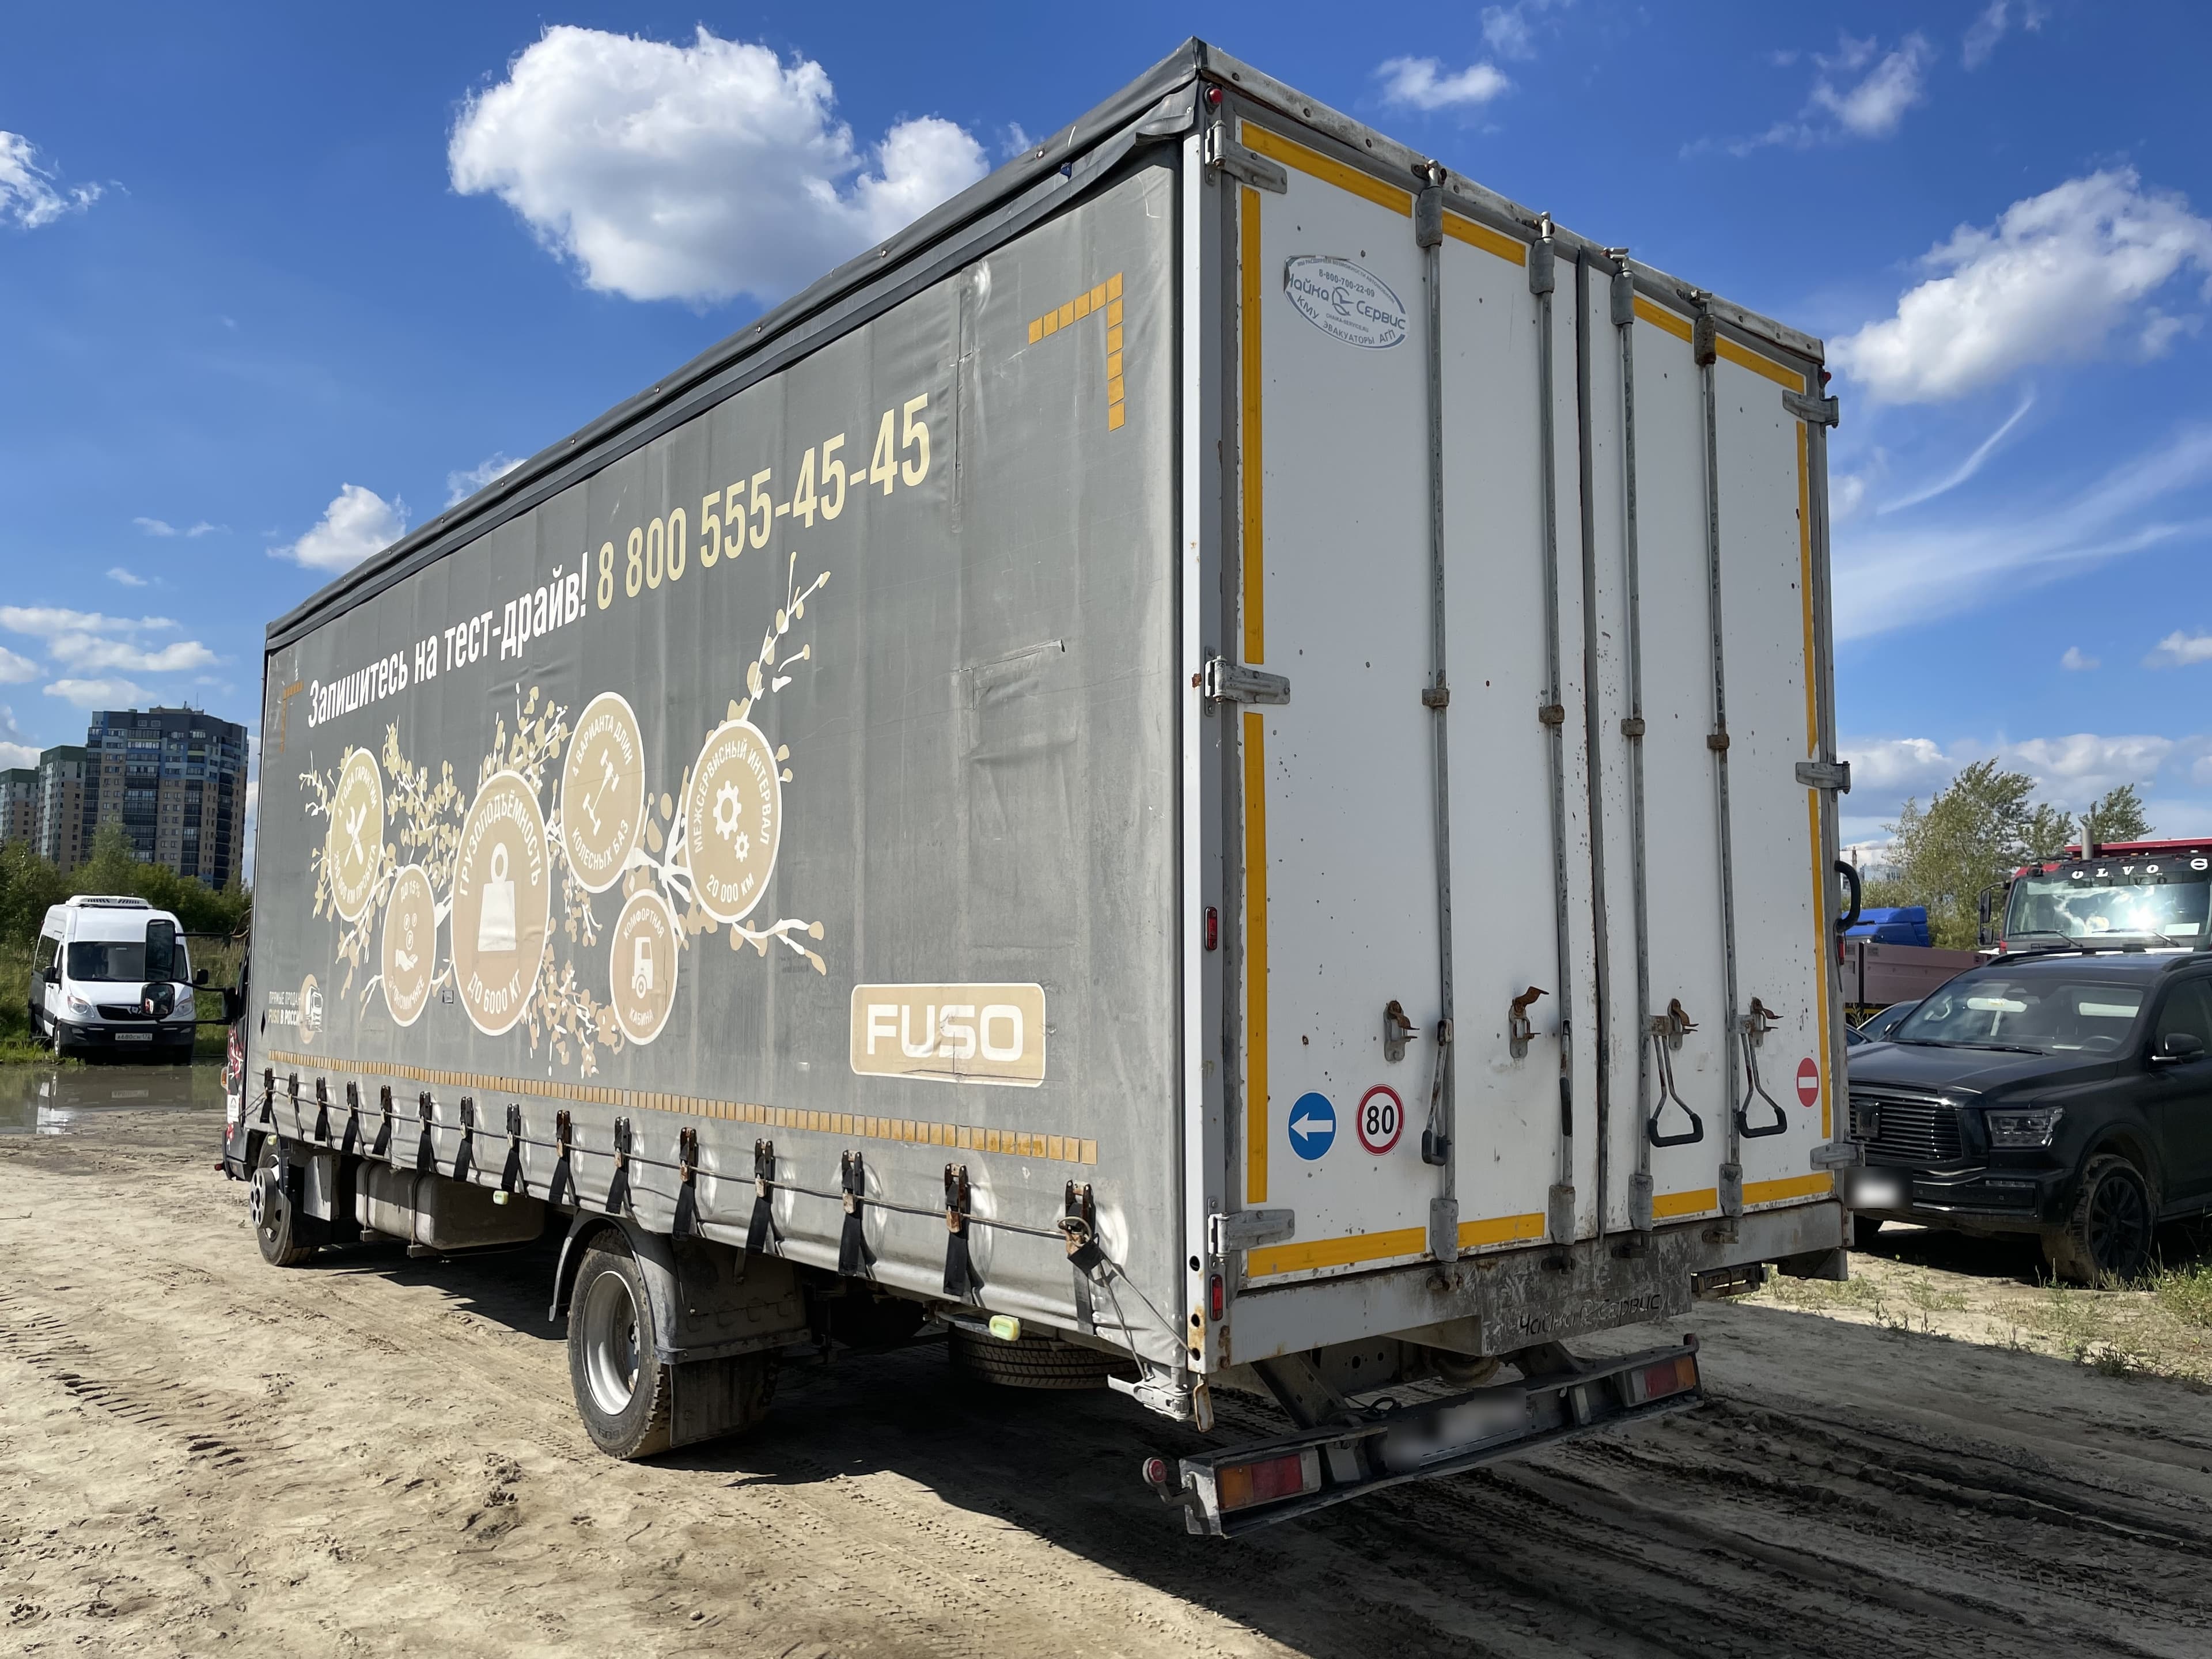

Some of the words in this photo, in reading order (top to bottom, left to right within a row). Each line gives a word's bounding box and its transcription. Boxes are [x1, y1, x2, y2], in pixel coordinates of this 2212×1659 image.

[1297, 295, 1319, 319] КМУ
[1323, 321, 1374, 344] ЭВАКУАТОРЫ
[1380, 329, 1396, 343] АГП
[1357, 301, 1406, 329] Сервис
[308, 650, 408, 729] Запишитесь
[414, 635, 438, 684] на
[444, 551, 588, 672] тест-драйв!
[597, 541, 613, 610] 8
[626, 507, 687, 598] 800
[700, 392, 931, 568] 555-45-45
[575, 714, 613, 765] ВАРИАНТА
[613, 721, 633, 765] ДЛИН
[340, 771, 354, 807] ГОДА
[355, 766, 377, 809] ГАРАНТИИ
[572, 766, 580, 778] 4
[692, 737, 748, 854] МЕЖСЕРВИСНЫЙ
[747, 748, 772, 845] ИНТЕРВАЛ
[459, 789, 543, 896] ГРУЗОПОДЪЁМНОСТЬ
[571, 827, 612, 870] КОЛЕСНЫХ
[613, 819, 628, 856] БАЗ
[338, 876, 347, 900] 000
[347, 888, 355, 904] КМ
[355, 845, 377, 901] ПРОБЕГА
[400, 884, 408, 903] ДО
[410, 880, 421, 899] 15%
[706, 874, 718, 898] 20
[720, 881, 738, 904] 000
[741, 872, 754, 895] КМ
[623, 907, 665, 940] КОМФОРТНАЯ
[389, 975, 424, 1010] ЭКОНОМИЧНЕЕ
[467, 972, 483, 1005] ДО
[483, 987, 508, 1014] 6000
[509, 968, 522, 1001] КГ
[280, 1009, 284, 1024] В
[628, 1007, 654, 1026] КАБИНА
[868, 1005, 1023, 1061] FUSO
[1366, 1105, 1394, 1135] 80
